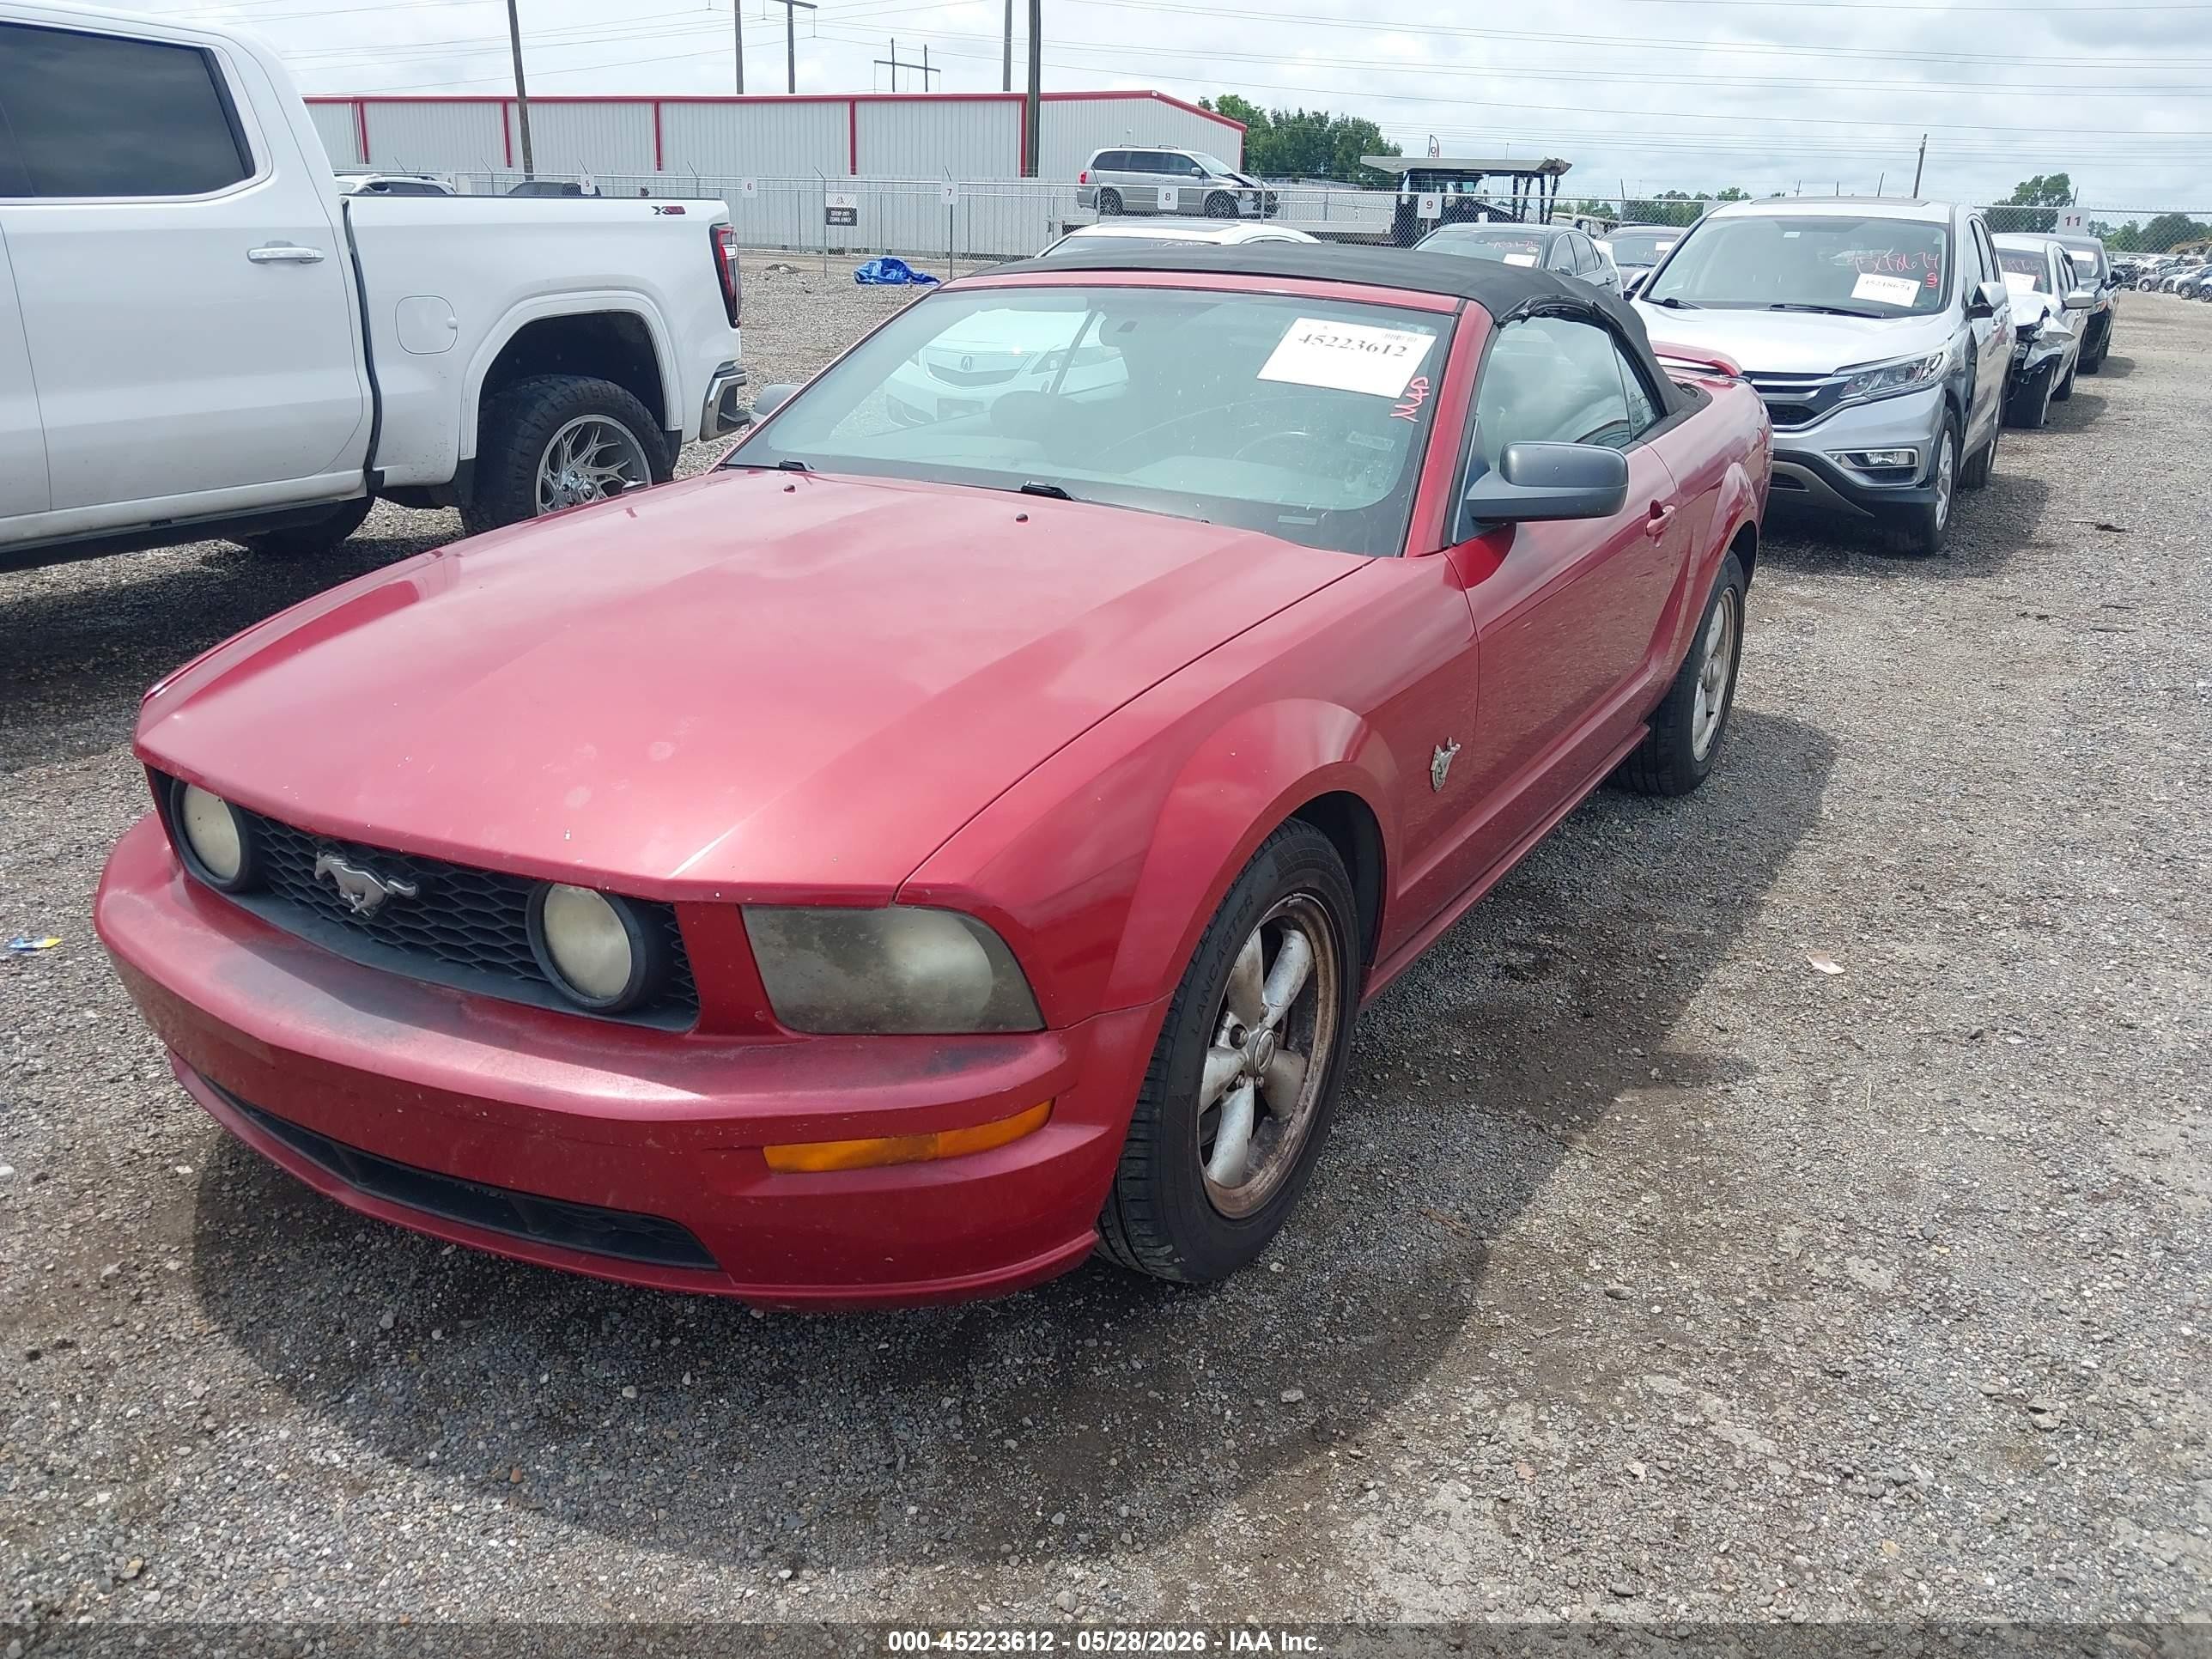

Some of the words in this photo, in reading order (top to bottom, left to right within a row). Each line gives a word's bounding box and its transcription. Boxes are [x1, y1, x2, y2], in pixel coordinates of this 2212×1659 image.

[946, 188, 952, 197] 7
[1164, 192, 1171, 201] 8
[1425, 200, 1433, 210] 9
[2064, 216, 2081, 227] 11
[1297, 332, 1409, 358] 45223612
[1192, 895, 1254, 1036] LANCASTER
